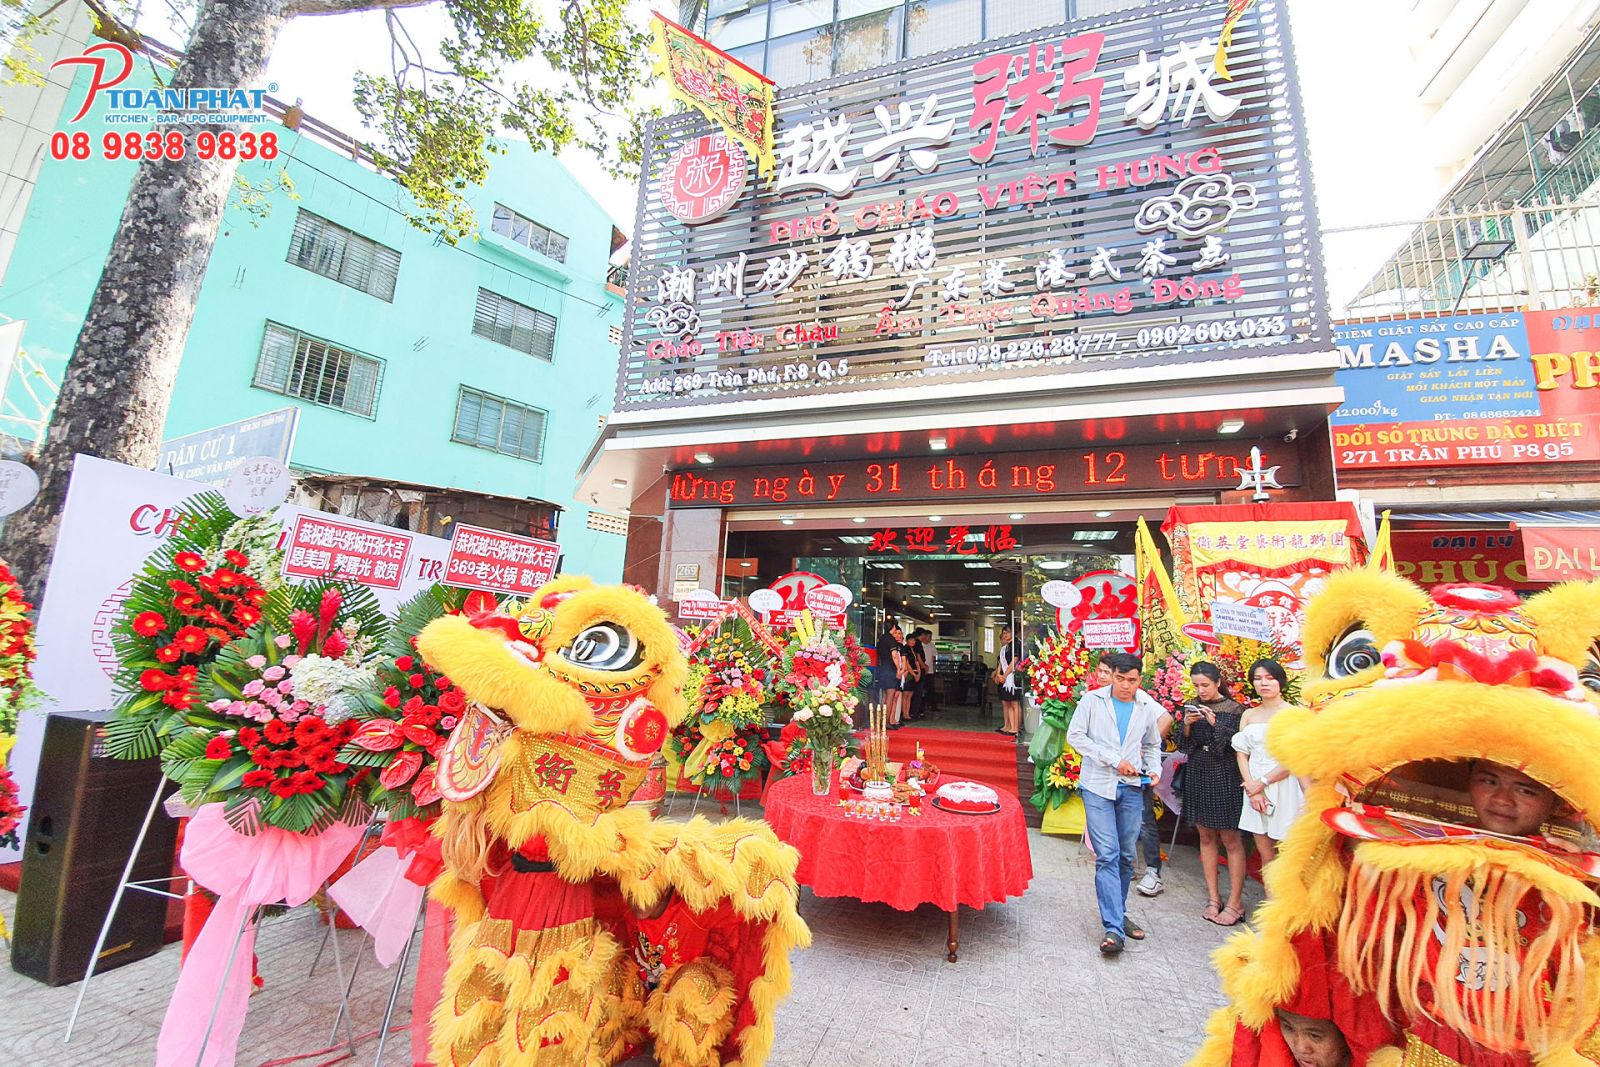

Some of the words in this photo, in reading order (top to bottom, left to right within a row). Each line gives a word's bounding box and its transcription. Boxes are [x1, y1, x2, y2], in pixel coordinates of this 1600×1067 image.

[684, 156, 722, 192] 粥
[854, 190, 960, 231] CHÁO
[978, 172, 1077, 213] VIỆT
[1096, 147, 1224, 191] HƯNG
[646, 335, 704, 360] Cháo
[776, 322, 839, 346] Châu
[1030, 284, 1134, 317] Quảng
[1152, 273, 1246, 303] Đông
[1334, 327, 1373, 341] TIỆM
[1420, 319, 1448, 333] SẤY
[1454, 320, 1484, 331] CAO
[1489, 314, 1520, 328] CẤP
[928, 349, 962, 367] Tel:
[1337, 334, 1520, 369] MASHA
[708, 368, 743, 388] Trần
[1420, 395, 1447, 403] GIAO
[1335, 424, 1372, 447] ĐỔI
[1376, 421, 1404, 444] SỐ
[1486, 419, 1528, 442] ĐẶC
[1533, 417, 1583, 441] BIỆT
[1342, 450, 1380, 464] 271
[1385, 443, 1448, 462] TRẦN
[1457, 440, 1502, 460] PHÚ
[754, 469, 845, 501] ngày
[866, 463, 901, 493] 31
[927, 459, 1055, 493] tháng
[1083, 451, 1128, 485] 12
[299, 522, 406, 560] 恭祝越兴粥城开张大吉
[456, 532, 555, 568] 恭祝越兴粥城开张大吉
[868, 525, 1018, 554] 欢迎光临
[1431, 536, 1477, 549] ĐẠI
[374, 561, 399, 581] 敬贺
[450, 559, 518, 584] 369老火锅
[520, 569, 548, 588] 敬贺
[1533, 547, 1583, 575] ĐẠI
